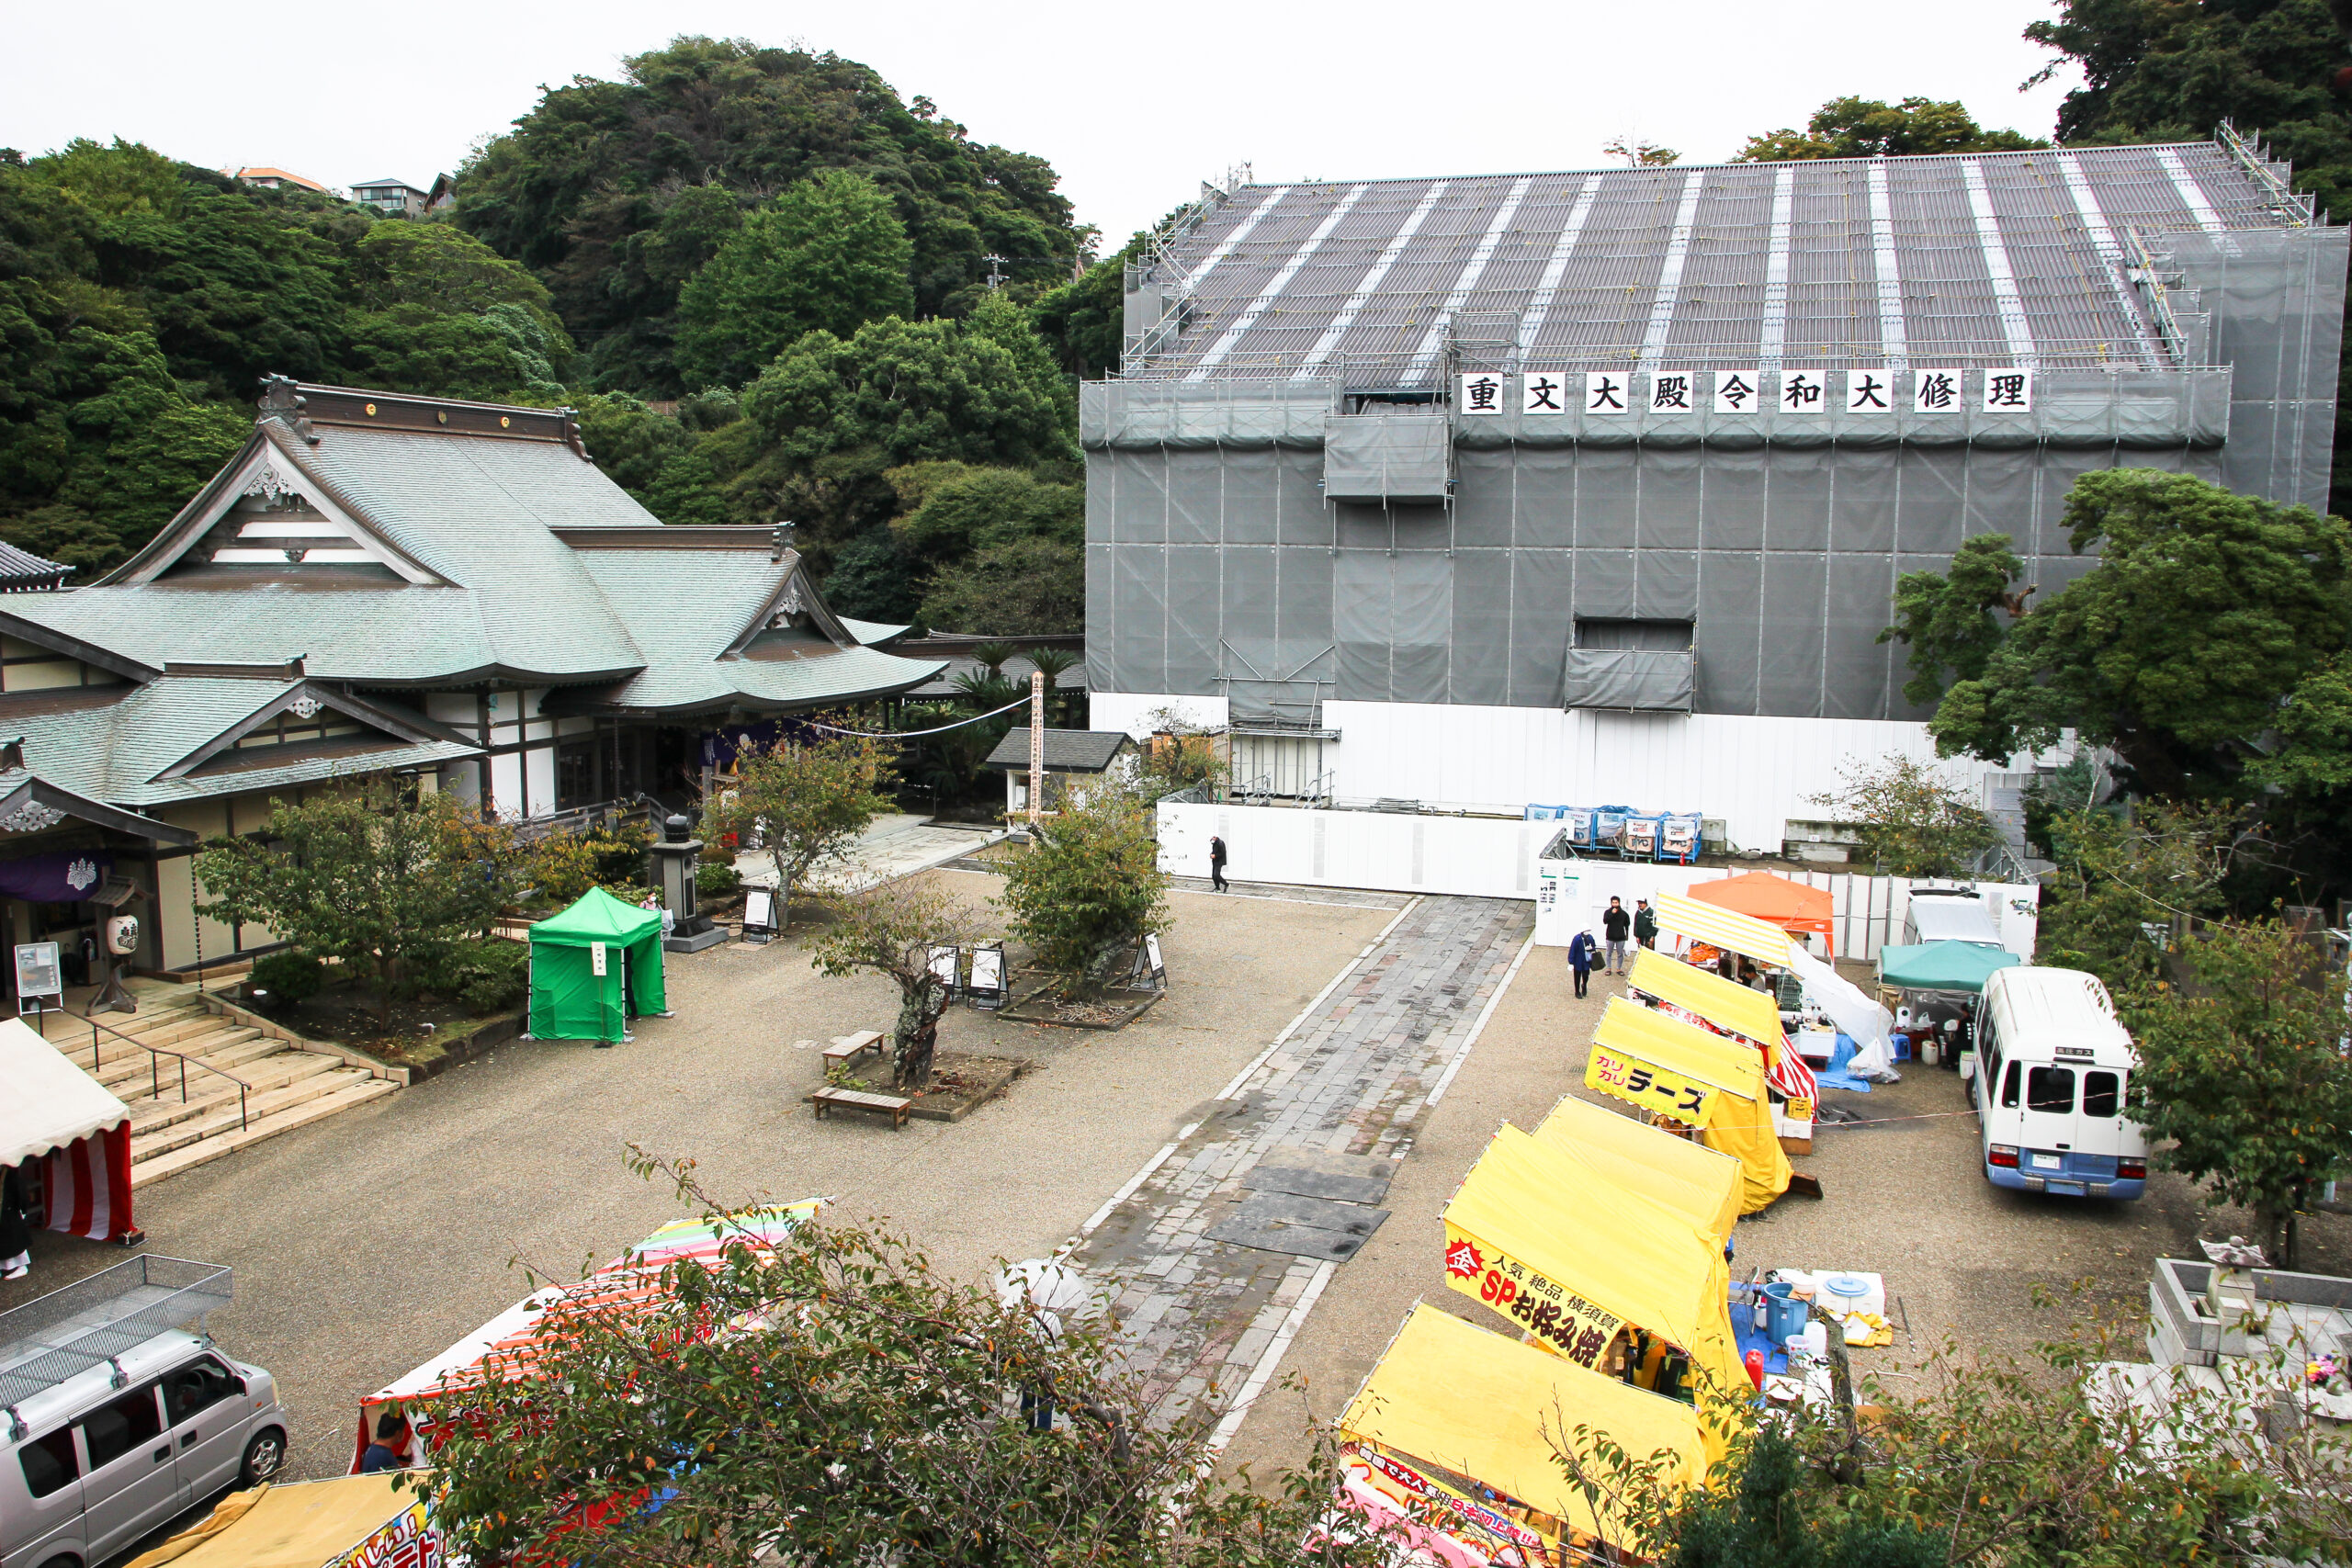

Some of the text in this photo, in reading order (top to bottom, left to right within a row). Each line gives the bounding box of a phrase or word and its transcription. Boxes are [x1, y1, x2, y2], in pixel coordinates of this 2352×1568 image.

[1466, 374, 2026, 411] 重文大殿令和大修理
[1596, 1055, 1624, 1071] カリ
[1599, 1070, 1625, 1086] カリ
[1626, 1068, 1706, 1115] チーズ
[1492, 1256, 1620, 1332] 人気 絶品 横須賀
